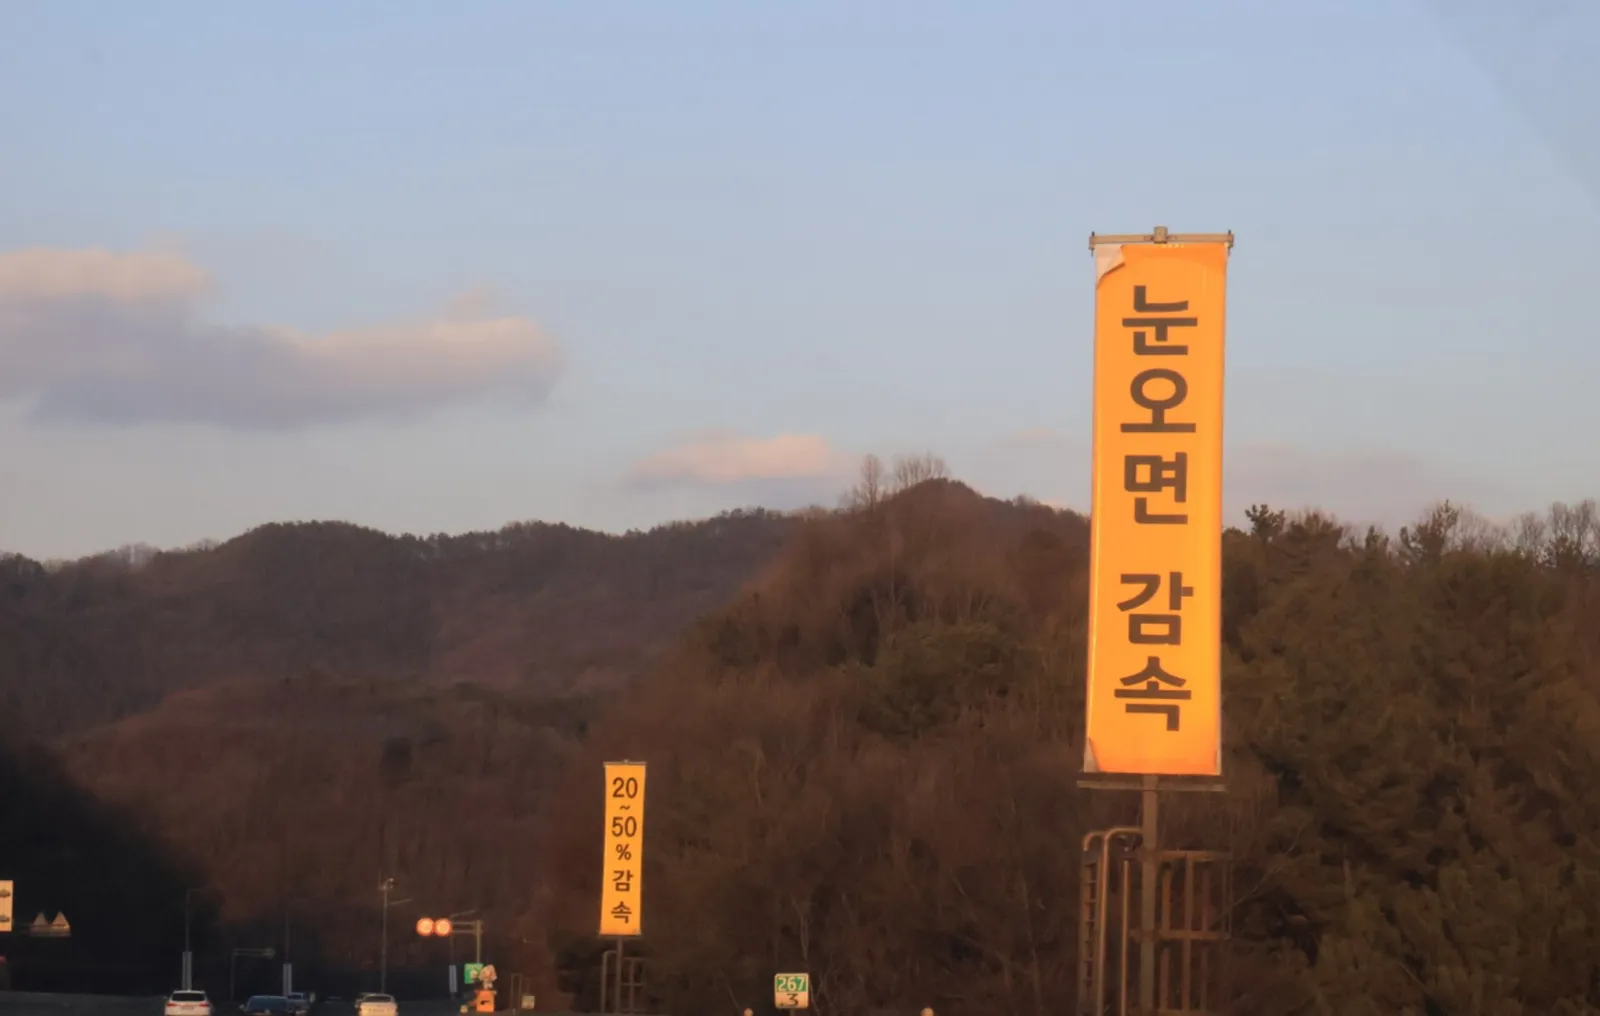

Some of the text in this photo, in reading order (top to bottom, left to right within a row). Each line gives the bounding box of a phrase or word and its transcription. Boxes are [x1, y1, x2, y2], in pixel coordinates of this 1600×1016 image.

[1113, 284, 1198, 732] 눈오면 감속
[611, 870, 633, 924] 감속
[778, 977, 805, 992] 267
